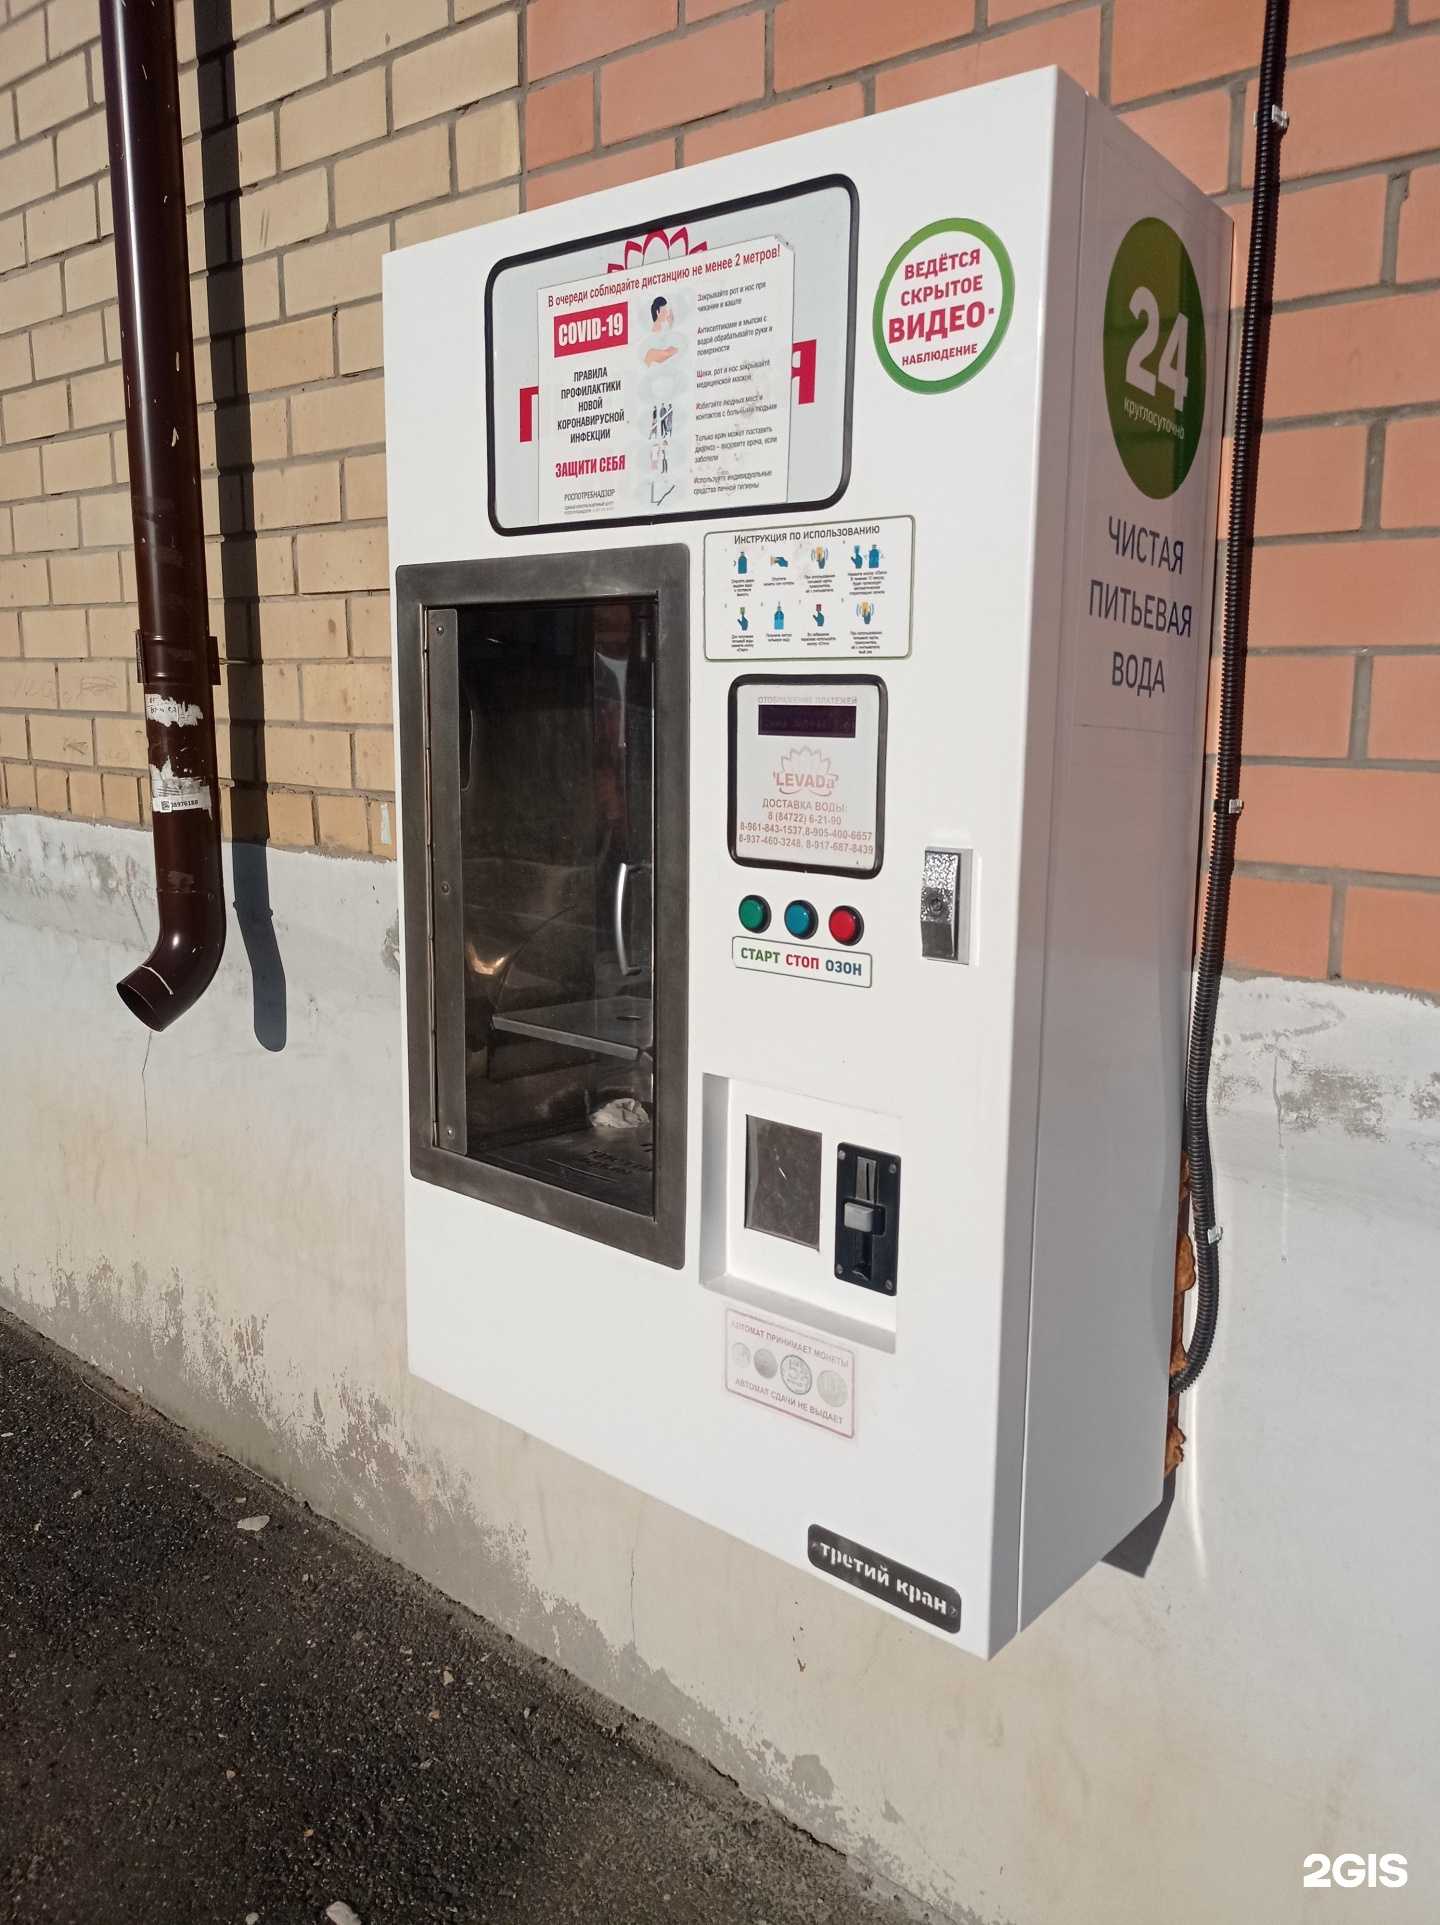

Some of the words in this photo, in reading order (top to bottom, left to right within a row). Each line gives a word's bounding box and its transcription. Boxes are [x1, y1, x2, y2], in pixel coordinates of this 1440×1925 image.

[548, 296, 554, 308] В
[556, 291, 588, 306] очереди
[590, 279, 640, 298] соблюдайте
[642, 267, 690, 289] дистанцию
[692, 264, 703, 276] не
[705, 258, 733, 274] менее
[735, 252, 741, 266] 2
[743, 243, 781, 264] метров!
[905, 248, 980, 280] ВЕДЁТСЯ
[900, 274, 983, 306] СКРЫТОЕ
[558, 312, 624, 346] COVID-19
[902, 344, 978, 366] НАБЛЮДЕНИЕ
[1125, 286, 1189, 412] 24
[574, 366, 608, 382] ПРАВИЛА
[561, 380, 622, 400] ПРОФИЛАКТИКИ
[578, 396, 603, 412] НОВОЙ
[558, 408, 625, 430] КОРОНАВИРУСНОЙ
[1124, 397, 1184, 440] круглосуточно
[570, 428, 610, 444] ИНФЕКЦИИ
[555, 458, 597, 478] ЗАЩИТИ
[599, 454, 626, 472] СЕБЯ
[564, 488, 616, 502] РОСПОТРЕБНАДЗОР
[803, 525, 880, 540] ИСПОЛЬЗОВАНИЮ
[1108, 516, 1184, 575] ЧИСТАЯ
[1088, 578, 1193, 638] ПИТЬЕВАЯ
[1111, 651, 1166, 698] ВОДА
[762, 798, 812, 810] ДОСТАВКА
[740, 947, 780, 964] СТАРТ
[785, 953, 820, 970] СТОП
[825, 960, 862, 976] ОЗОН
[770, 1390, 796, 1406] СДАЧИ
[820, 1542, 890, 1587] третий
[896, 1578, 947, 1616] кран
